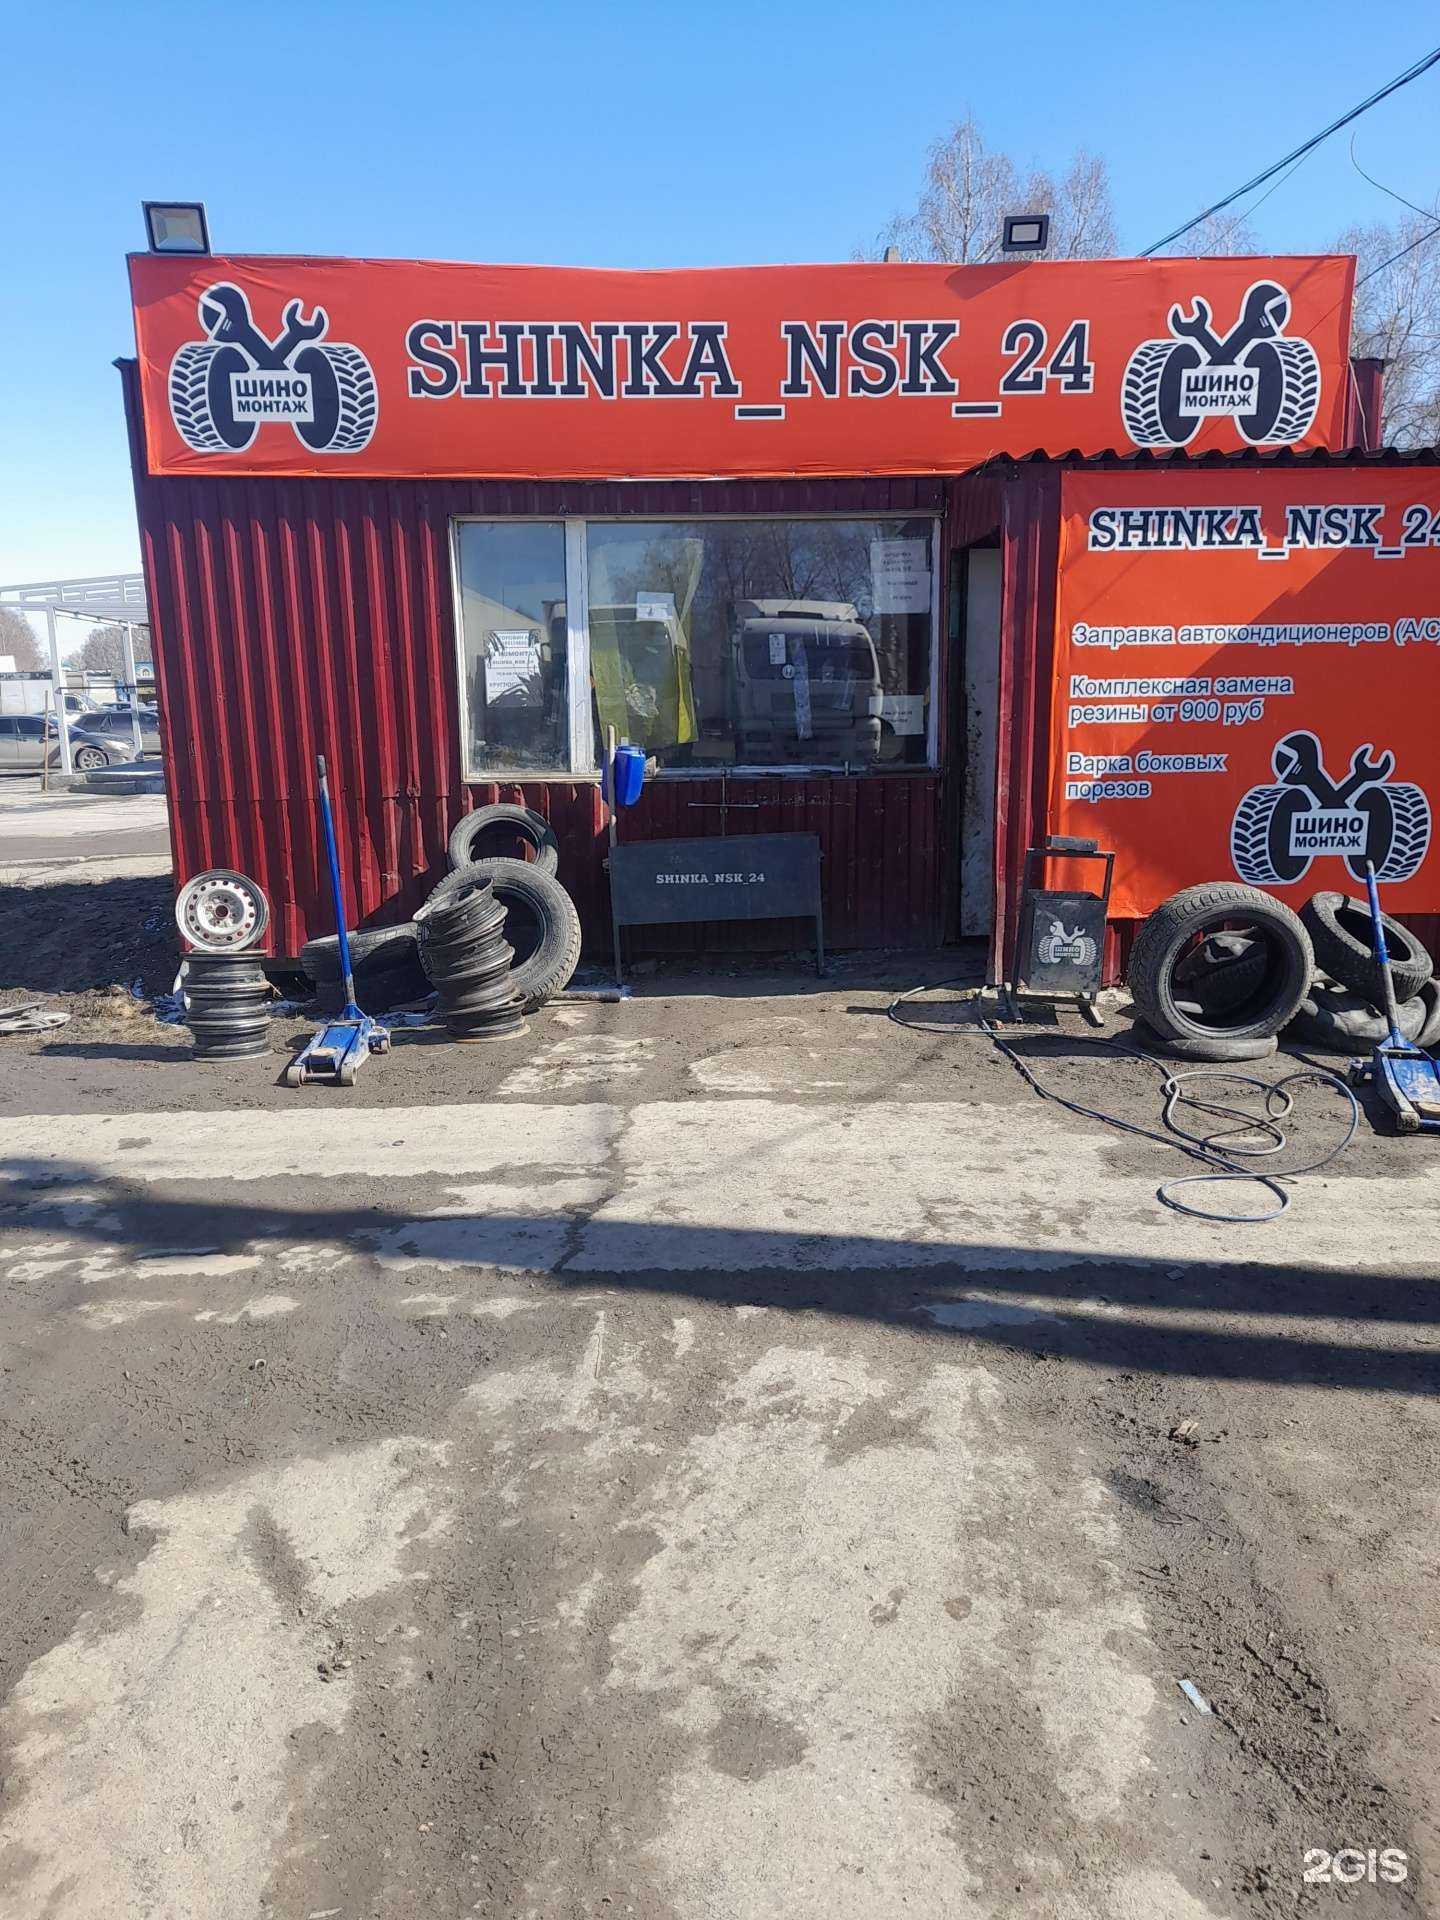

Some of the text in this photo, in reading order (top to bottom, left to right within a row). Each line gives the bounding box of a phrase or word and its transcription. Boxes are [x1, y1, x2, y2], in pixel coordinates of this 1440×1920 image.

[235, 379, 308, 398] ШИНО
[1186, 371, 1254, 393] ШИНО
[236, 399, 309, 415] МОНТАЖ
[1184, 393, 1252, 409] МОНТАЖ
[1074, 624, 1173, 648] Заправка
[1180, 624, 1389, 646] автокондиционеров
[1071, 677, 1293, 697] Комплексная замена
[1070, 700, 1263, 725] резины от 900 руб
[1068, 752, 1227, 775] Варка боковых
[1067, 780, 1150, 801] порезов
[1295, 816, 1364, 834] ШИНО
[1294, 835, 1361, 849] МОНТАЖ
